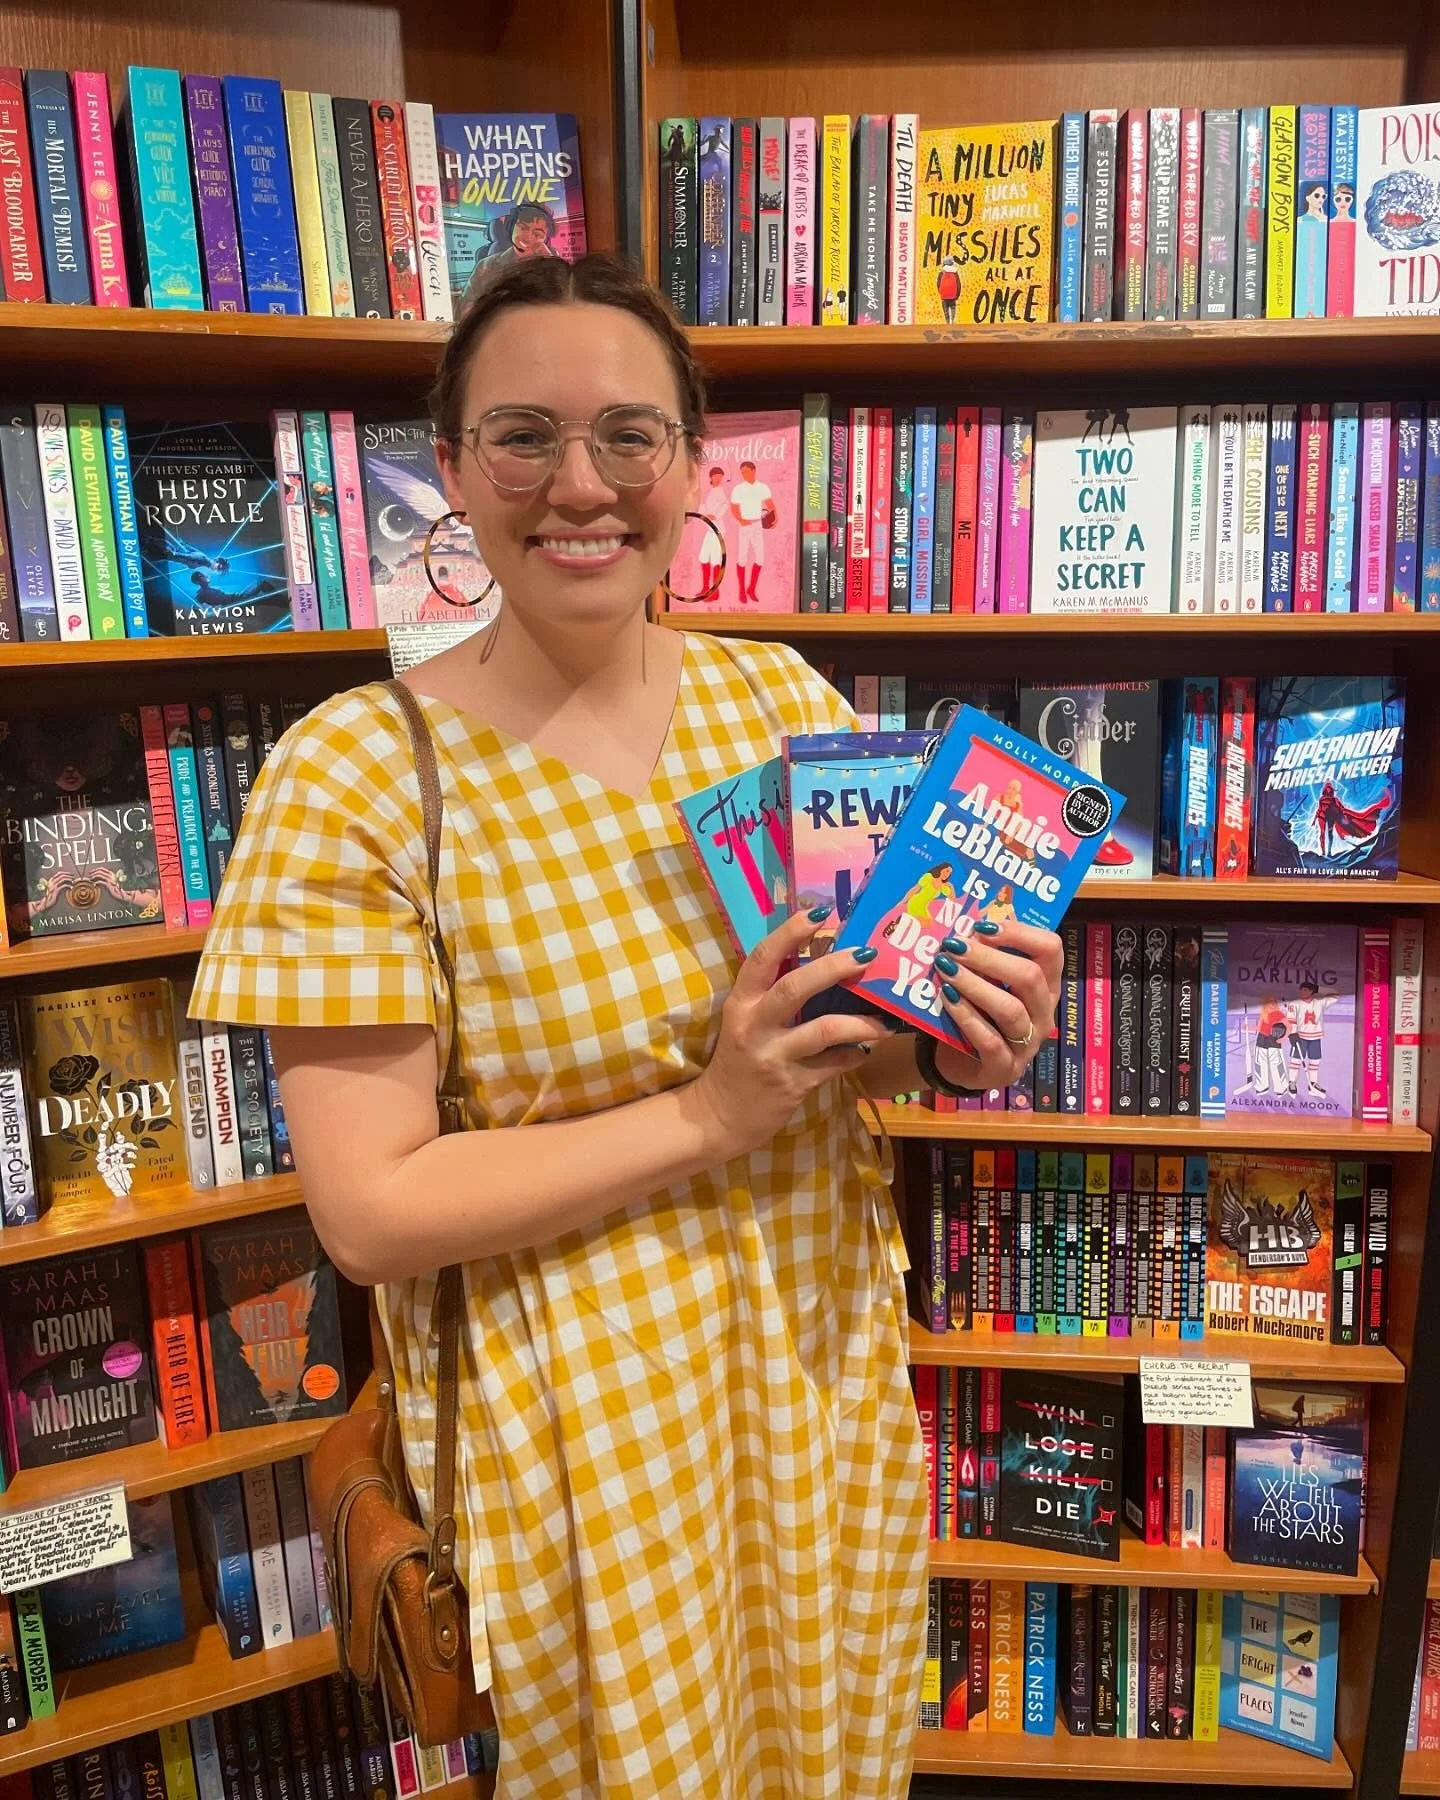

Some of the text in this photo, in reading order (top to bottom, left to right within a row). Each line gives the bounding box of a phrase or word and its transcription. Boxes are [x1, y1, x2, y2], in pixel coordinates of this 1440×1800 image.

[47, 120, 56, 135] HIS
[87, 92, 105, 178] JENNY LEE
[464, 124, 545, 150] WHAT
[1304, 113, 1314, 177] ROYALS
[925, 140, 1045, 183] A MILLION
[1336, 113, 1348, 180] MAJESTY
[45, 137, 68, 205] MORTAL
[347, 117, 374, 244] NEVER HERO
[445, 153, 572, 179] HAPPENS
[1272, 115, 1293, 234] GLASGOW BOYS
[462, 173, 560, 205] ONLINE
[895, 157, 913, 213] DEATH
[1094, 158, 1108, 236] SUPREME
[674, 167, 688, 248] SUMMONER
[928, 192, 974, 226] TINY
[2, 170, 33, 283] BLOODCARVER
[53, 207, 77, 273] DEMISE
[93, 215, 118, 270] Anna
[923, 224, 1040, 268] MISSILES
[1094, 240, 1107, 256] LIE
[986, 266, 1033, 280] ALL AT
[974, 285, 1042, 324] ONCE
[363, 424, 406, 449] SPIN
[78, 418, 104, 534] DAVID LEVITHAN
[109, 418, 133, 532] DAVID LEVITHAN
[205, 465, 255, 474] GAMBIT
[1075, 448, 1133, 476] TWO
[1191, 442, 1204, 510] NOTHING MORE
[158, 478, 247, 500] HEIST
[1078, 486, 1126, 513] CAN
[1245, 471, 1263, 535] COUSINS
[1304, 434, 1321, 545] SUCH CHARMING LIARS
[144, 503, 264, 527] ROYALE
[958, 520, 971, 540] ME
[1274, 511, 1288, 538] NEXT
[1334, 466, 1349, 579] Some Cold
[893, 507, 907, 589] STORM LIES
[1059, 524, 1145, 552] KEEP A
[851, 540, 863, 597] AND SECRETS
[915, 551, 928, 600] MISSING
[1057, 562, 1145, 591] SECRET
[176, 606, 256, 619] KAYVION
[1052, 596, 1148, 607] KAREN McMANUS
[190, 623, 244, 635] LEWIS
[993, 734, 1038, 764] MOLLY
[1269, 727, 1401, 771] SUPERNOVA
[1188, 746, 1208, 827] RENEGADES
[1224, 742, 1245, 830] ARCHENEMIES
[1264, 755, 1393, 791] MARISSA MEYER
[802, 785, 915, 829] REW
[958, 782, 1061, 859] Annie
[1068, 807, 1099, 828] AUTHOR
[1072, 799, 1104, 821] BY THE
[1075, 791, 1106, 813] SIGNED
[7, 808, 147, 844] BINDING
[696, 779, 772, 865] This
[41, 838, 121, 869] SPELL
[922, 801, 1061, 903] LeBlanc
[962, 869, 990, 900] Is
[1350, 868, 1379, 876] ANARCHY
[39, 909, 134, 927] MARISA LINTON
[935, 898, 976, 938] No
[1237, 967, 1338, 985] DARLING
[1211, 984, 1219, 1025] DARLING
[37, 1080, 176, 1137] DEADLY
[185, 1053, 207, 1139] LEGEND
[211, 1050, 233, 1145] CHAMPION
[1231, 1099, 1340, 1111] ALEXANDRA MOODY
[8, 1152, 26, 1195] FOUR
[1369, 1189, 1388, 1250] GONE WILD
[10, 1263, 96, 1296] SARAH
[35, 1285, 108, 1314] MAAS
[1208, 1281, 1326, 1323] THE ESCAPE
[32, 1306, 115, 1356] CROWN
[1209, 1312, 1324, 1341] Robert Muchamore
[70, 1359, 84, 1380] OF
[166, 1334, 195, 1428] HEIR FIRE
[30, 1379, 138, 1436] MIDNIGHT
[1034, 1402, 1085, 1425] WIN
[940, 1407, 955, 1515] PUMPKIN
[1025, 1433, 1094, 1459] LOSE
[1029, 1465, 1088, 1490] KILL
[1256, 1478, 1334, 1507] WE TELL
[1282, 1465, 1319, 1486] LIES
[1036, 1498, 1080, 1520] DIE
[1258, 1498, 1341, 1524] ABOUT
[1252, 1516, 1344, 1544] THE STARS
[1250, 1616, 1268, 1633] THE
[23, 1638, 48, 1693] MURDER
[973, 1644, 982, 1694] RELEASE
[995, 1591, 1012, 1720] PATRICK NESS
[1028, 1592, 1045, 1722] PATRICK NESS
[1241, 1654, 1275, 1675] BRIGHT
[1240, 1693, 1273, 1713] PLACES
